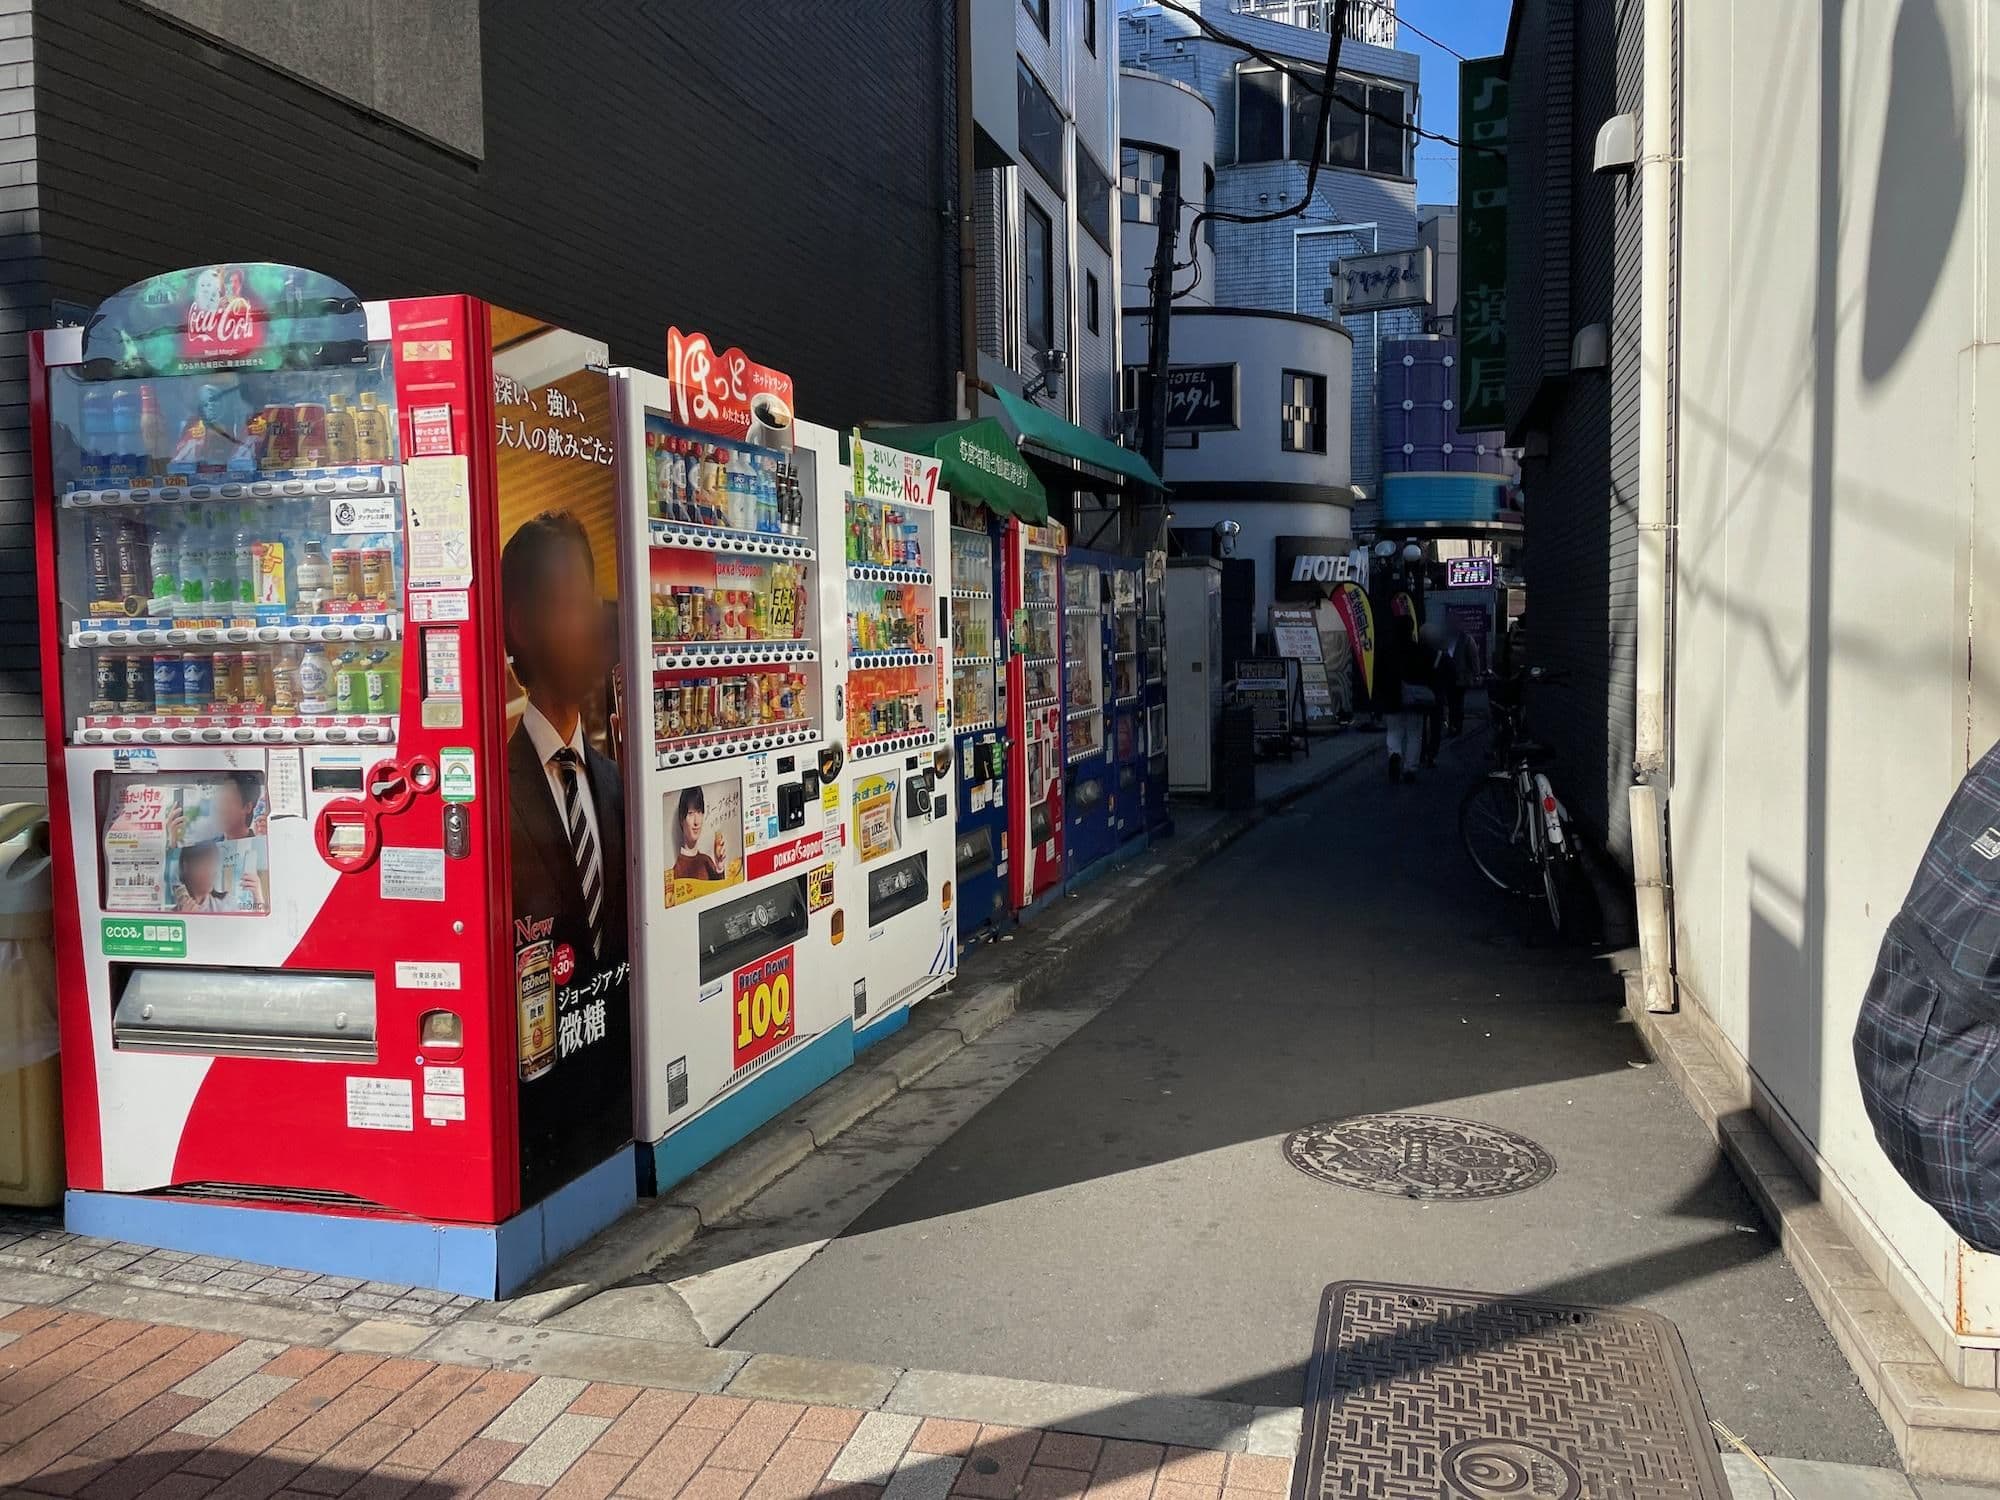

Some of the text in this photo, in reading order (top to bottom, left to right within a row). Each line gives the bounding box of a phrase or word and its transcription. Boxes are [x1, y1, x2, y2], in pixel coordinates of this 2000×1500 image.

[188, 298, 254, 343] Coca-Cola
[672, 335, 747, 426] ほっと
[1166, 380, 1220, 422] リスタル
[1292, 554, 1352, 581] HOTEL
[120, 788, 161, 804] 当たり付き
[852, 779, 896, 806] おすすめ
[514, 915, 555, 947] New
[558, 969, 614, 1011] ジョージア
[558, 999, 607, 1058] 微糖
[738, 973, 790, 1050] 100
